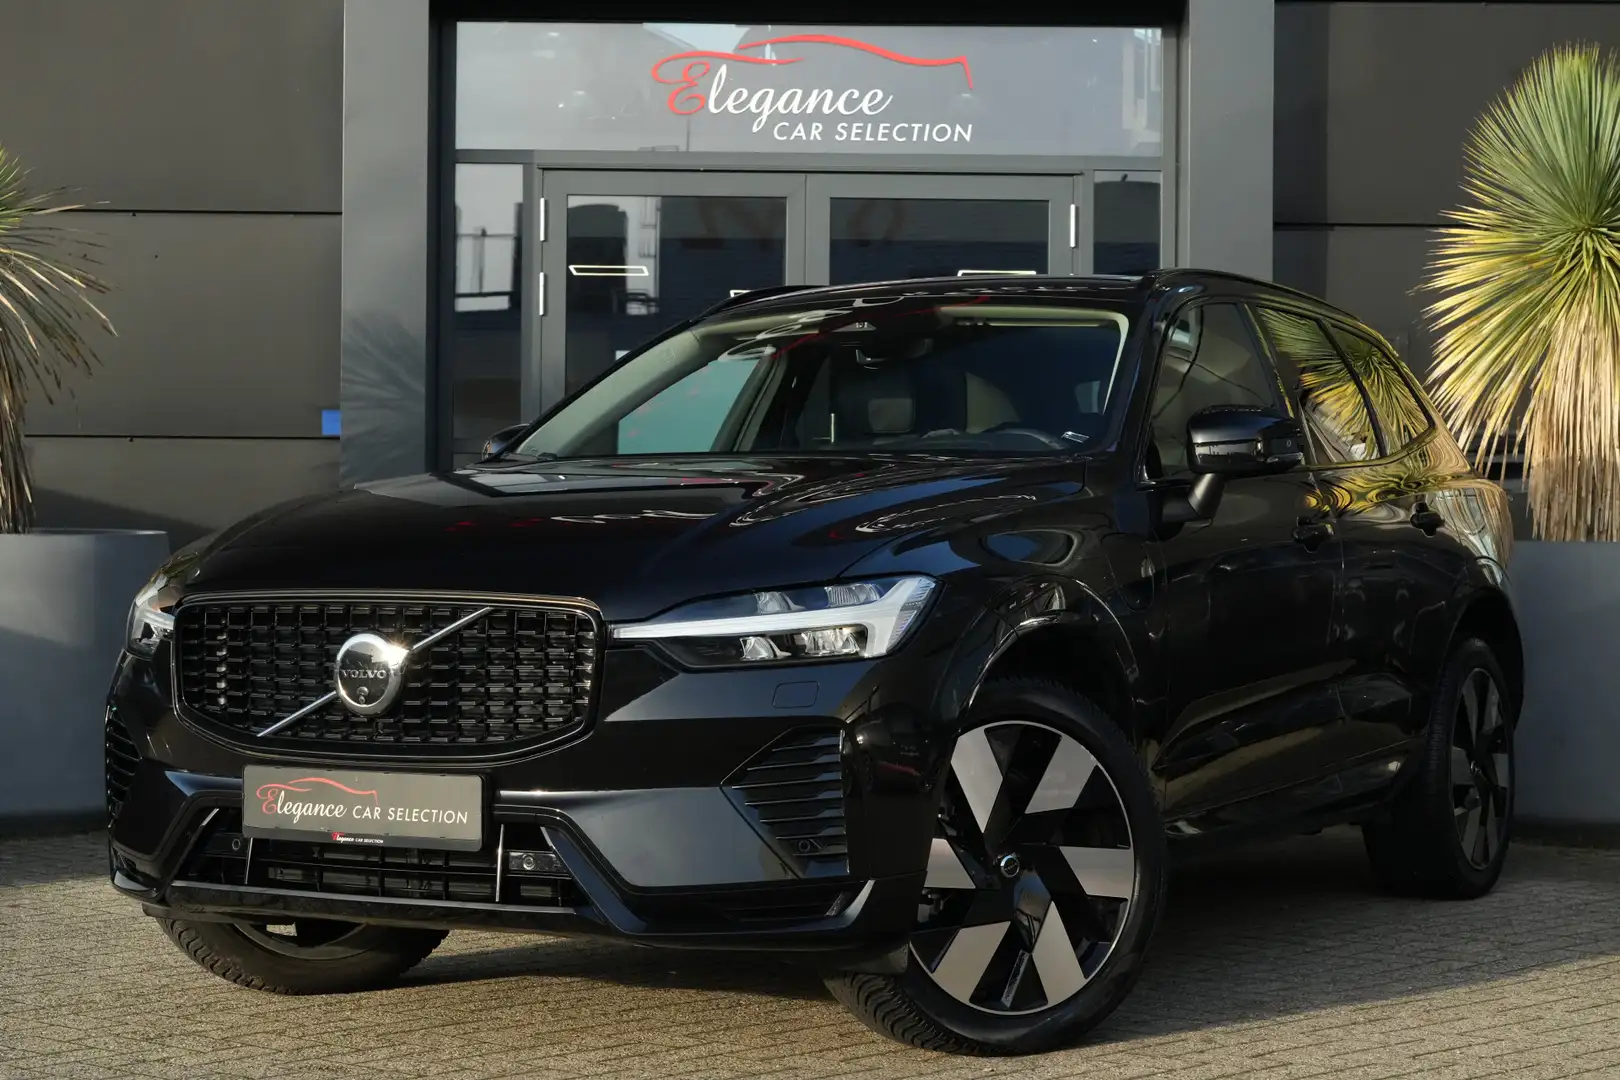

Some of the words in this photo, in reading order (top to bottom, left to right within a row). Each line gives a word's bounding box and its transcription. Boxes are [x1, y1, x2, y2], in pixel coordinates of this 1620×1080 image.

[652, 50, 893, 133] Elegance
[773, 122, 824, 141] CAR
[835, 123, 973, 142] SELECTION
[342, 669, 387, 679] VOLVO
[256, 784, 348, 824] Elegance
[352, 805, 381, 820] CAR
[388, 807, 468, 824] SELECTION
